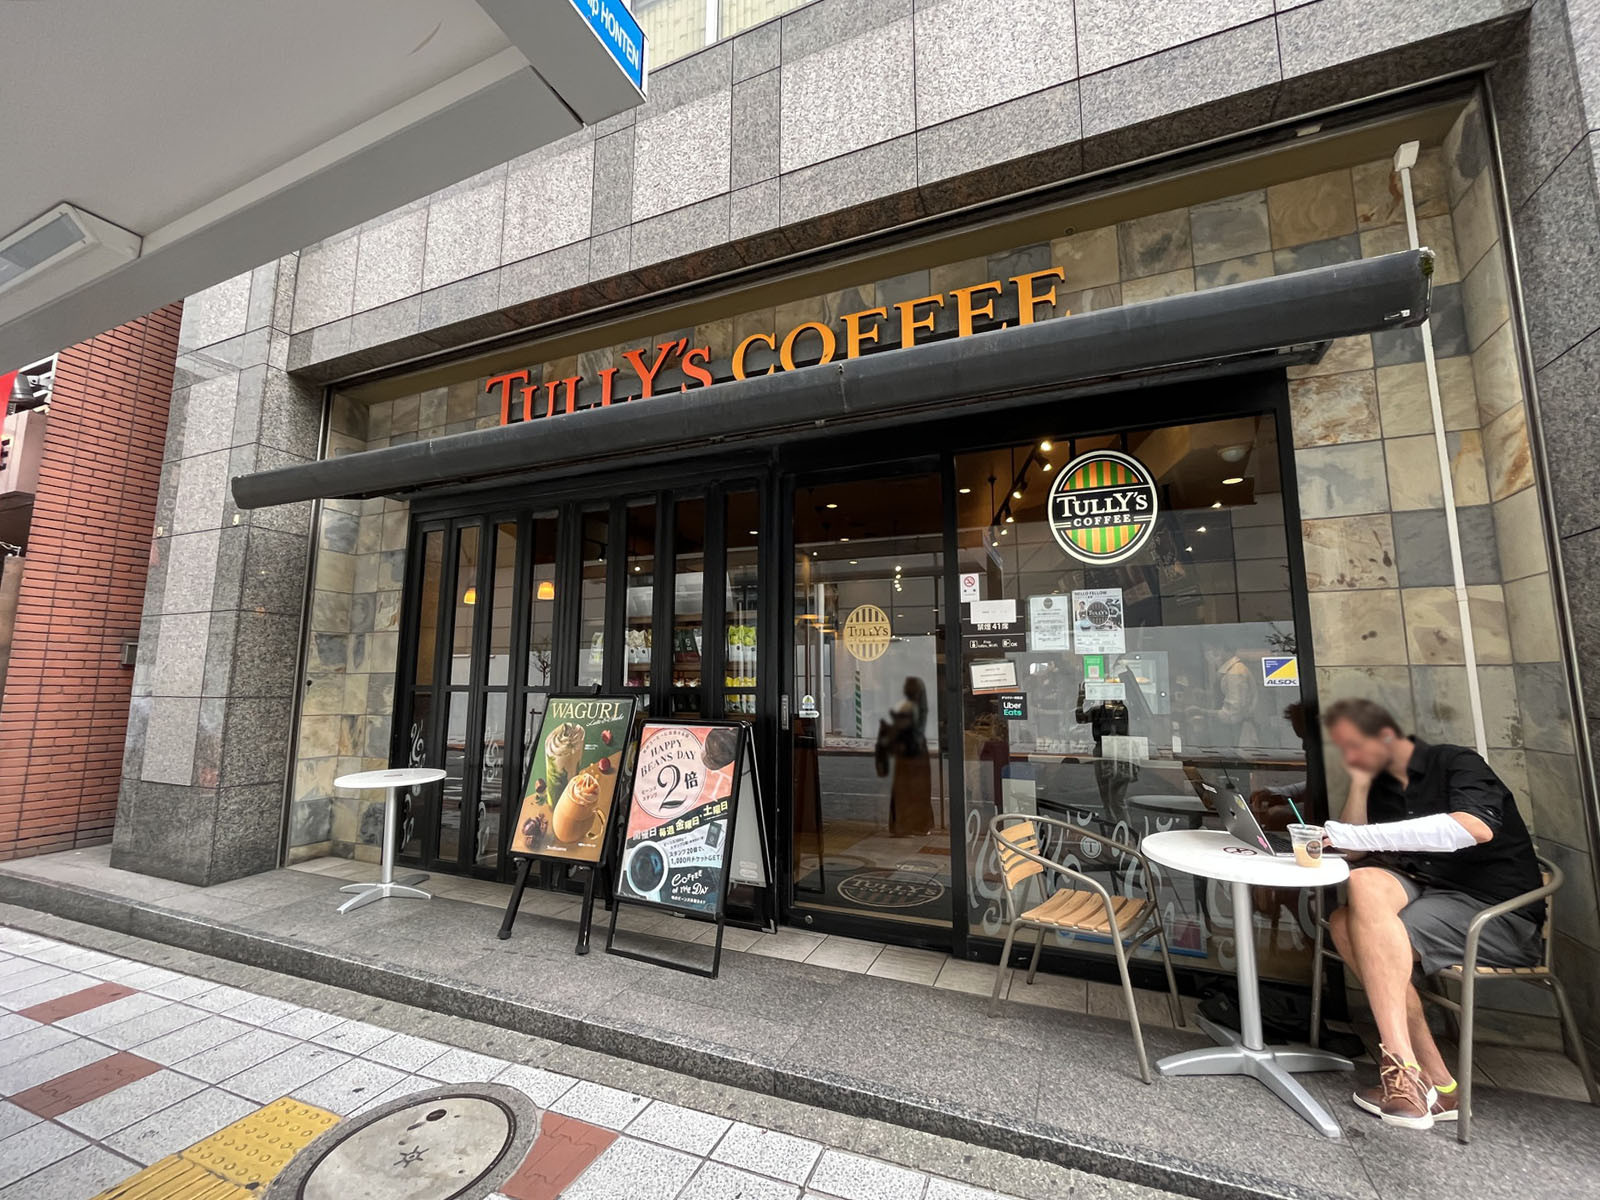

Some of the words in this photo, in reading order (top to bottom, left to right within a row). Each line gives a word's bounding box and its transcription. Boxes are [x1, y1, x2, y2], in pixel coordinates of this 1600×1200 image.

[601, 1, 639, 71] HONTEN
[485, 338, 713, 426] TULLY'S
[731, 266, 1066, 381] COFFEE
[1056, 491, 1148, 517] TULLY'S
[1073, 514, 1131, 527] COFFEE
[846, 625, 889, 637] TULLY'S
[551, 702, 621, 719] WAGURI
[1003, 701, 1022, 709] Uber
[651, 739, 683, 757] HAPPY
[640, 751, 674, 777] BEANS
[677, 750, 697, 761] DAY
[671, 869, 703, 887] COFFEE
